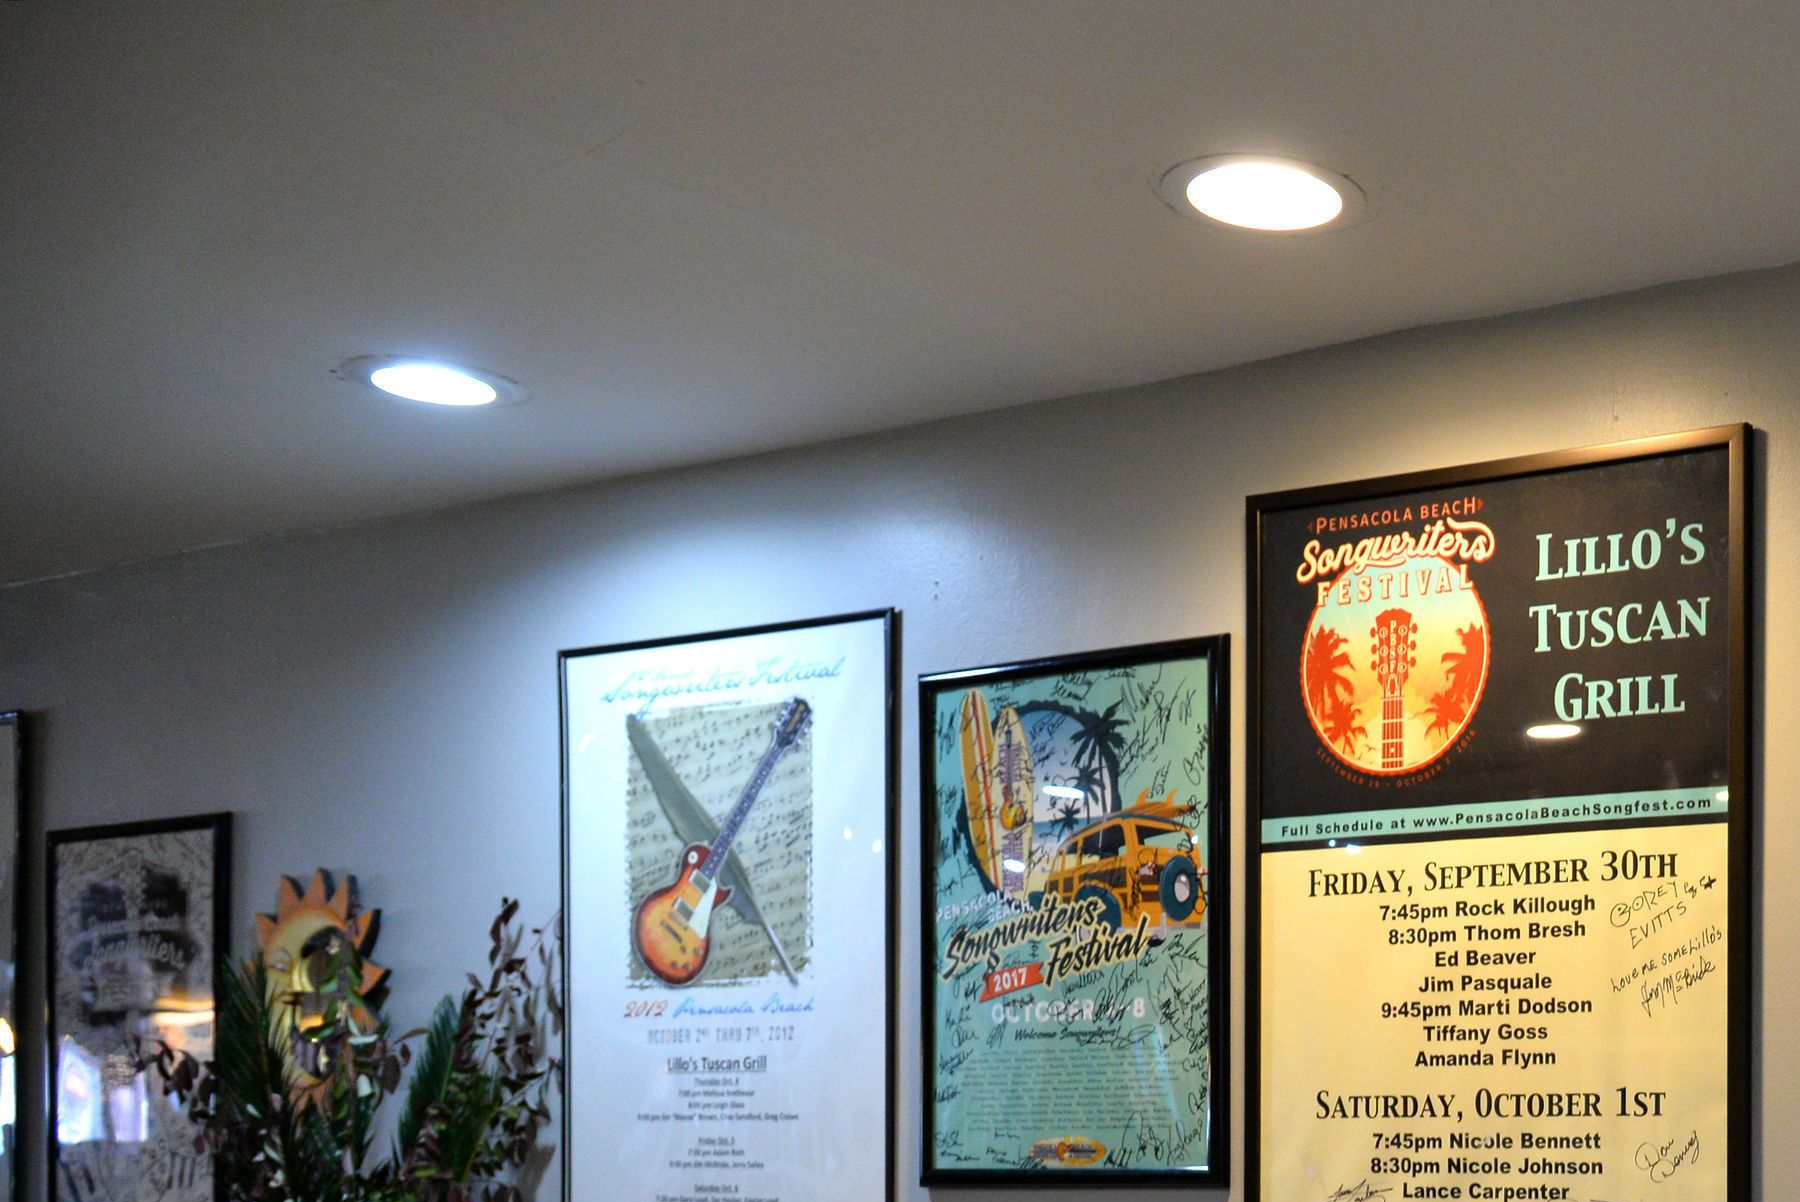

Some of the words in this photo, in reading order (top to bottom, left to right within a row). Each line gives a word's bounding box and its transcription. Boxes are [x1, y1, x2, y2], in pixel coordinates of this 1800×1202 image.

[1315, 506, 1413, 535] PENSACOLA
[1419, 496, 1479, 521] BEACH
[1296, 516, 1496, 585] Songwriters
[1534, 518, 1707, 582] LILLO'S
[1316, 565, 1475, 608] FESTIVAL
[1528, 596, 1711, 654] TUSCAN
[749, 654, 848, 686] Festival
[1553, 672, 1686, 723] GRILL
[1281, 823, 1308, 837] Full
[1315, 818, 1383, 835] Schedule
[1390, 816, 1405, 829] at
[1412, 798, 1711, 828] www.PensacolaBeachSongfest.com
[1308, 868, 1412, 897] FRIDAY,
[1423, 857, 1589, 891] SEPTEMBER
[1600, 851, 1678, 881] 30TH
[936, 887, 1013, 922] PENSACOLA
[1378, 902, 1448, 922] 7:45pm
[1454, 898, 1505, 917] Rock
[1512, 893, 1595, 916] Killough
[943, 891, 1102, 981] Songwriters
[1387, 926, 1456, 947] 8:30pm
[1463, 924, 1521, 941] Thom
[1527, 920, 1586, 939] Bresh
[1045, 914, 1148, 987] Festival
[1434, 949, 1458, 967] Ed
[1465, 949, 1536, 966] Beaver
[993, 966, 1028, 993] 2017
[1417, 975, 1454, 993] Jim
[1460, 972, 1552, 994] Pasquale
[624, 1000, 668, 1018] 2012
[761, 991, 815, 1014] Beach
[991, 998, 1095, 1025] OCTOBER
[1380, 1000, 1451, 1021] 9:45pm
[1458, 999, 1510, 1016] Marti
[1517, 997, 1592, 1014] Dodson
[648, 1029, 691, 1044] OCTOBER
[768, 1025, 796, 1042] 2012
[1014, 1027, 1056, 1041] Welcome
[1422, 1024, 1491, 1043] Tiffany
[1497, 1023, 1548, 1040] Goss
[667, 1056, 698, 1072] Lillo's
[701, 1056, 741, 1071] Tuscan
[743, 1055, 767, 1071] Grill
[1414, 1048, 1494, 1067] Amanda
[1501, 1048, 1556, 1068] Flynn
[1315, 1089, 1463, 1122] SATURDAY,
[1474, 1087, 1602, 1118] OCTOBER
[1615, 1085, 1666, 1117] 1ST
[1371, 1132, 1442, 1153] 7:45pm
[1449, 1131, 1513, 1149] Nicole
[1520, 1131, 1601, 1149] Bennett
[1370, 1156, 1440, 1178] 8:30pm
[1447, 1156, 1511, 1174] Nicole
[1517, 1156, 1603, 1175] Johnson
[1402, 1181, 1461, 1199] Lance
